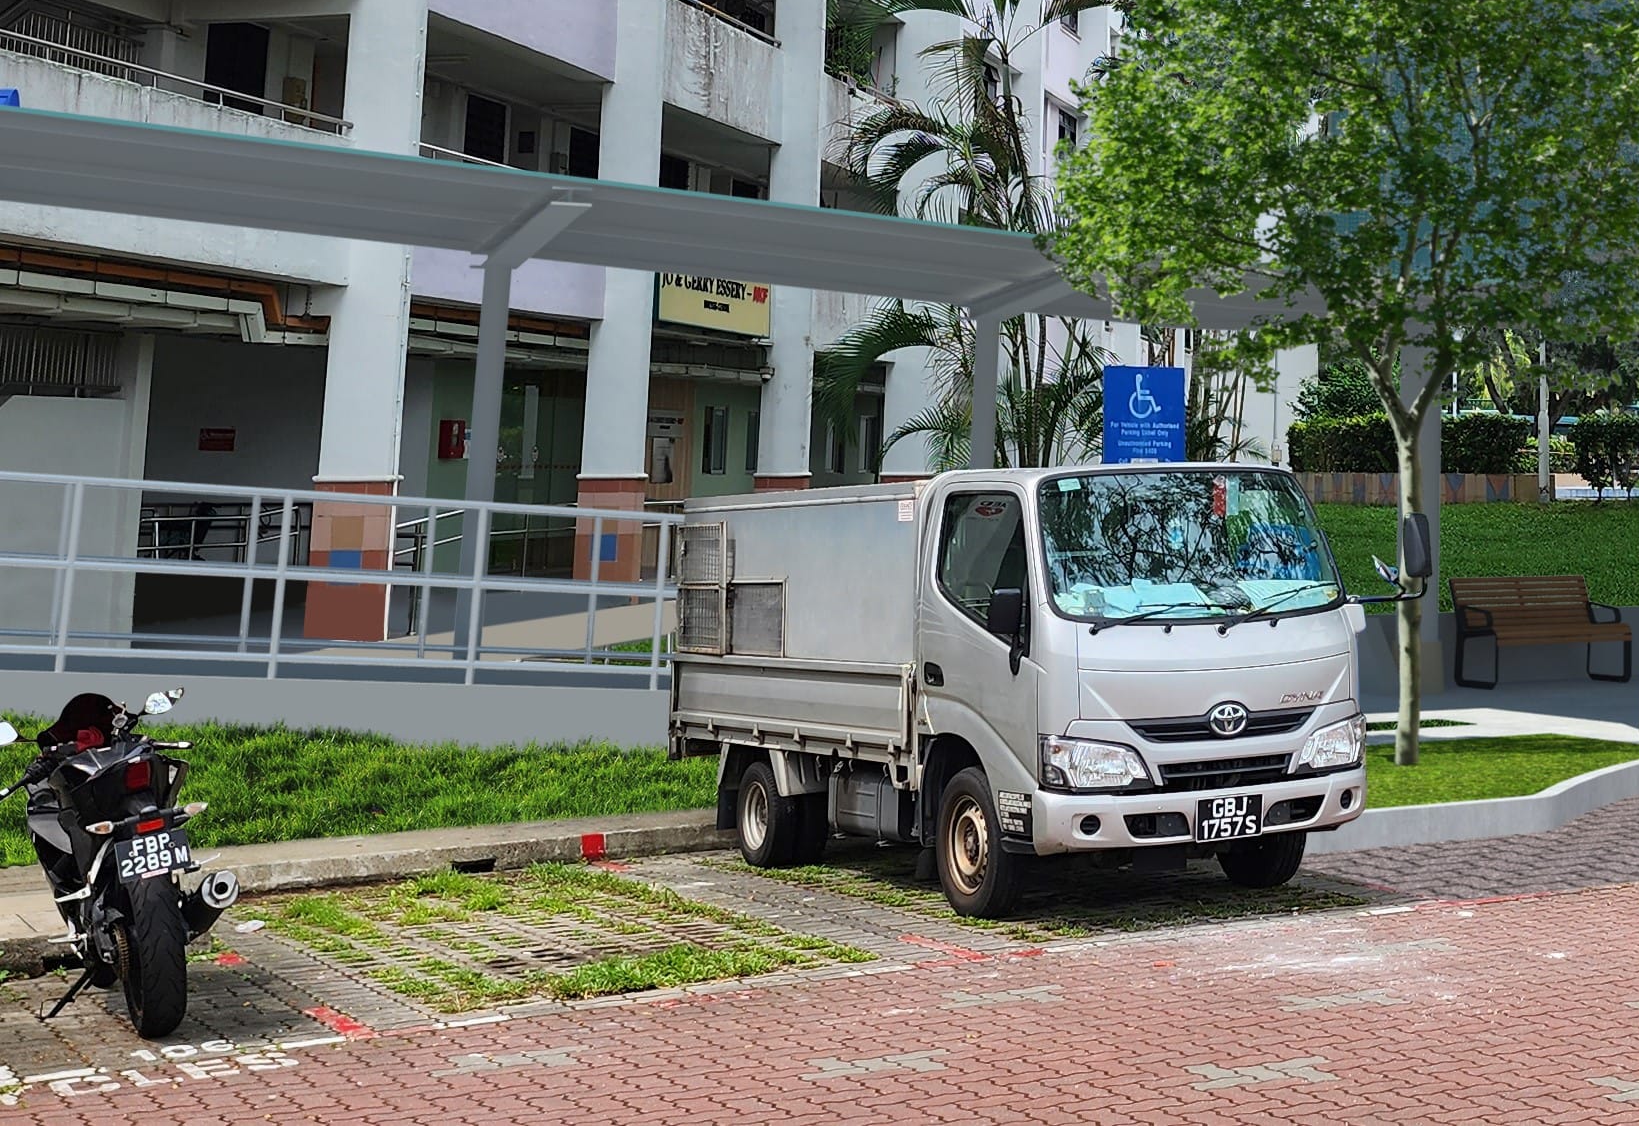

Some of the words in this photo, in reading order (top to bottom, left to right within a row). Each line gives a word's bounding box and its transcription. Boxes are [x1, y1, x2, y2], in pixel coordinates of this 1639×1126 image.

[1212, 796, 1248, 818] GBJ
[132, 832, 170, 857] FBP
[130, 1039, 235, 1062] 106
